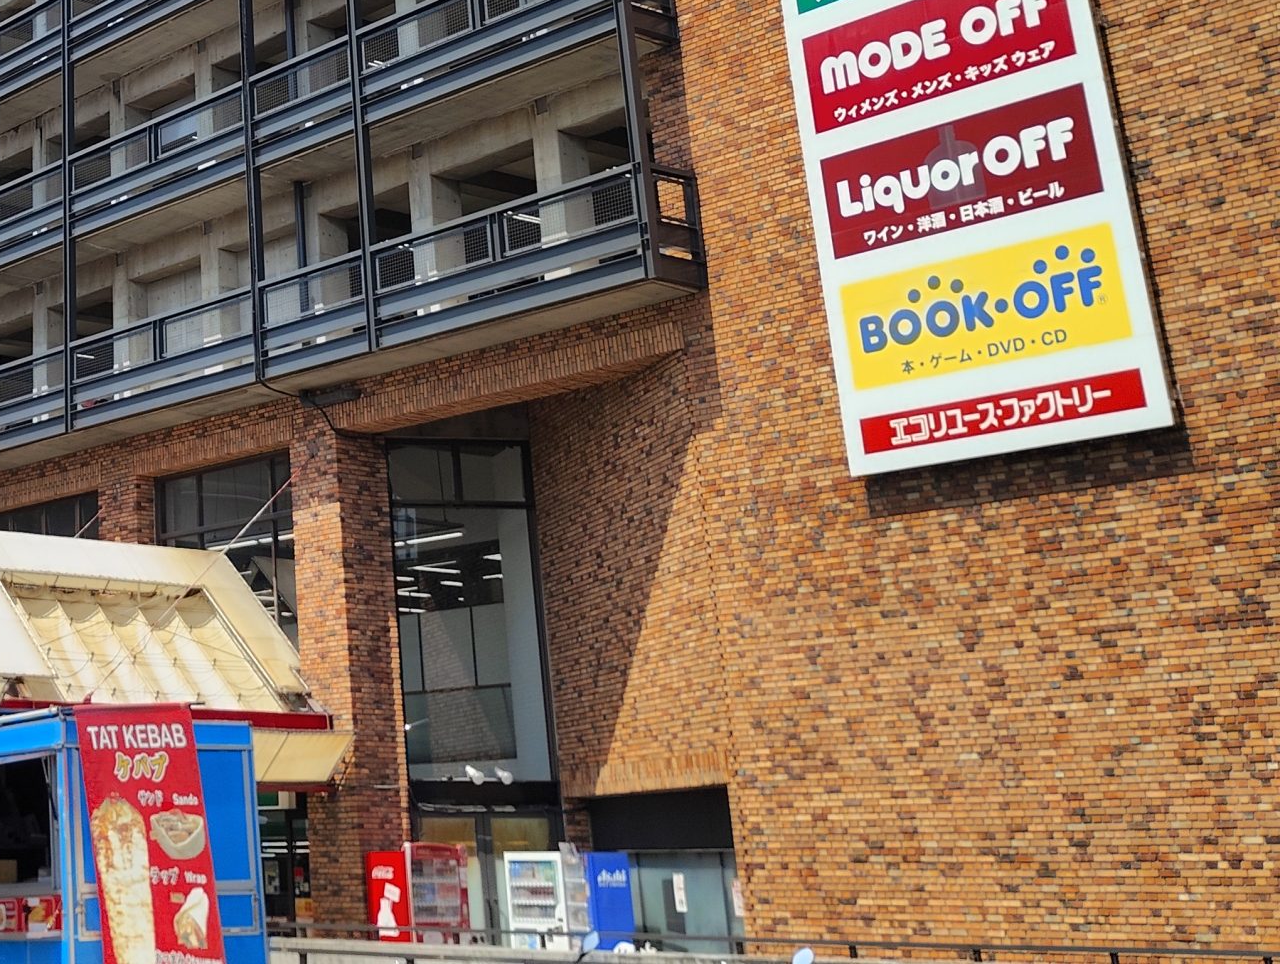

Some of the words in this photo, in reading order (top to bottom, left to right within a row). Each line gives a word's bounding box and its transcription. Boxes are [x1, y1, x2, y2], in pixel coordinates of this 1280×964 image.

[820, 18, 951, 95] MODE
[836, 150, 979, 218] Liquor
[982, 117, 1074, 176] OFF
[86, 725, 119, 750] TAT
[122, 722, 188, 749] KEBAB
